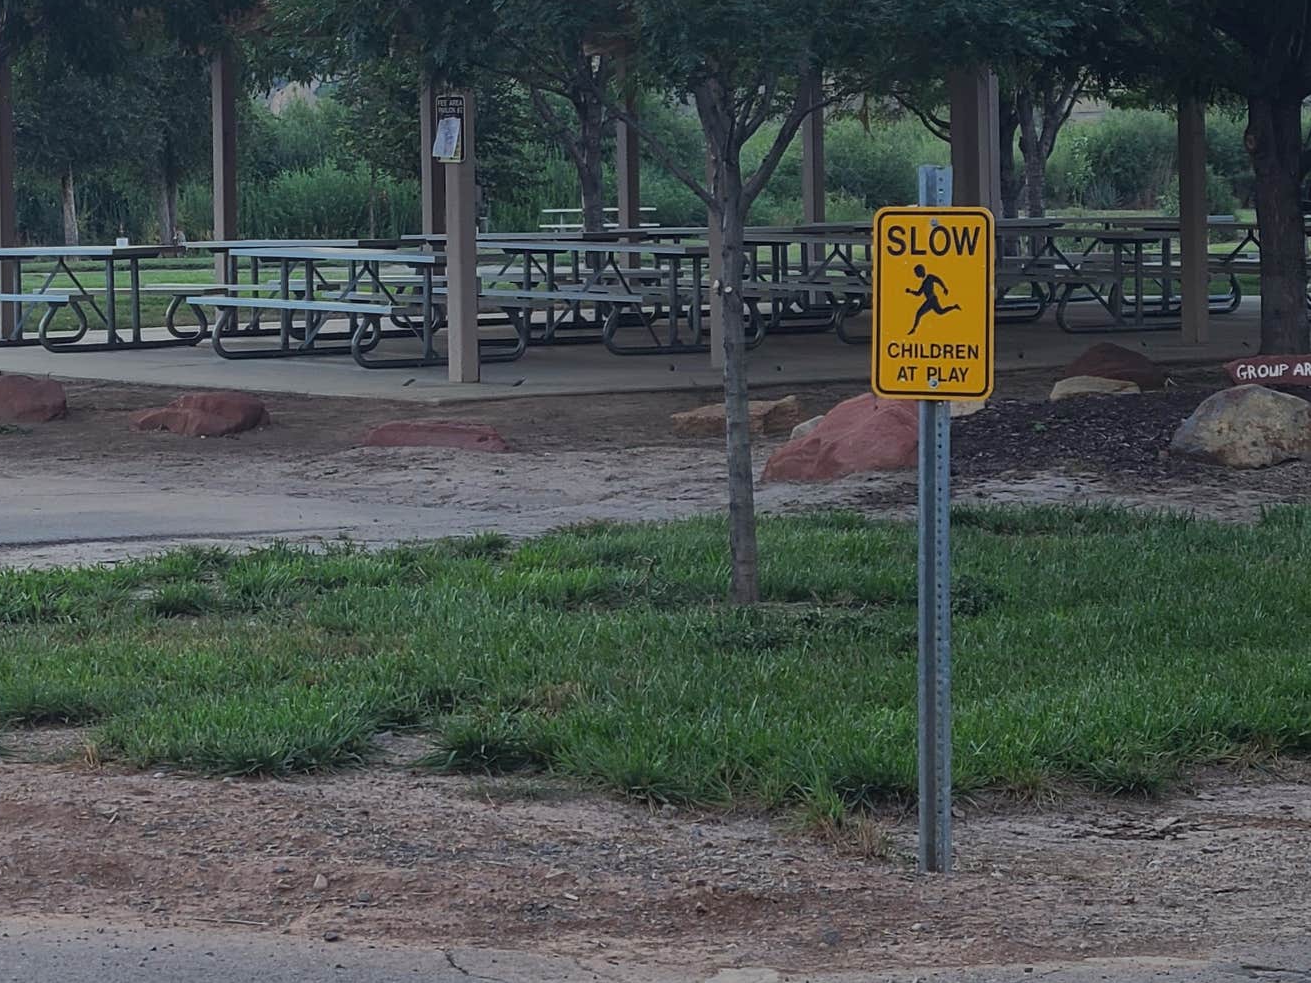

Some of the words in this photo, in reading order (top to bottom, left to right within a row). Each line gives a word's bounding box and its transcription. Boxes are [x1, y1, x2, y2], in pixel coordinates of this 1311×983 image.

[887, 225, 981, 256] SLOW
[887, 342, 979, 360] CHILDREN
[897, 366, 918, 382] AT
[927, 366, 969, 383] PLAY
[1236, 363, 1289, 380] GROUP
